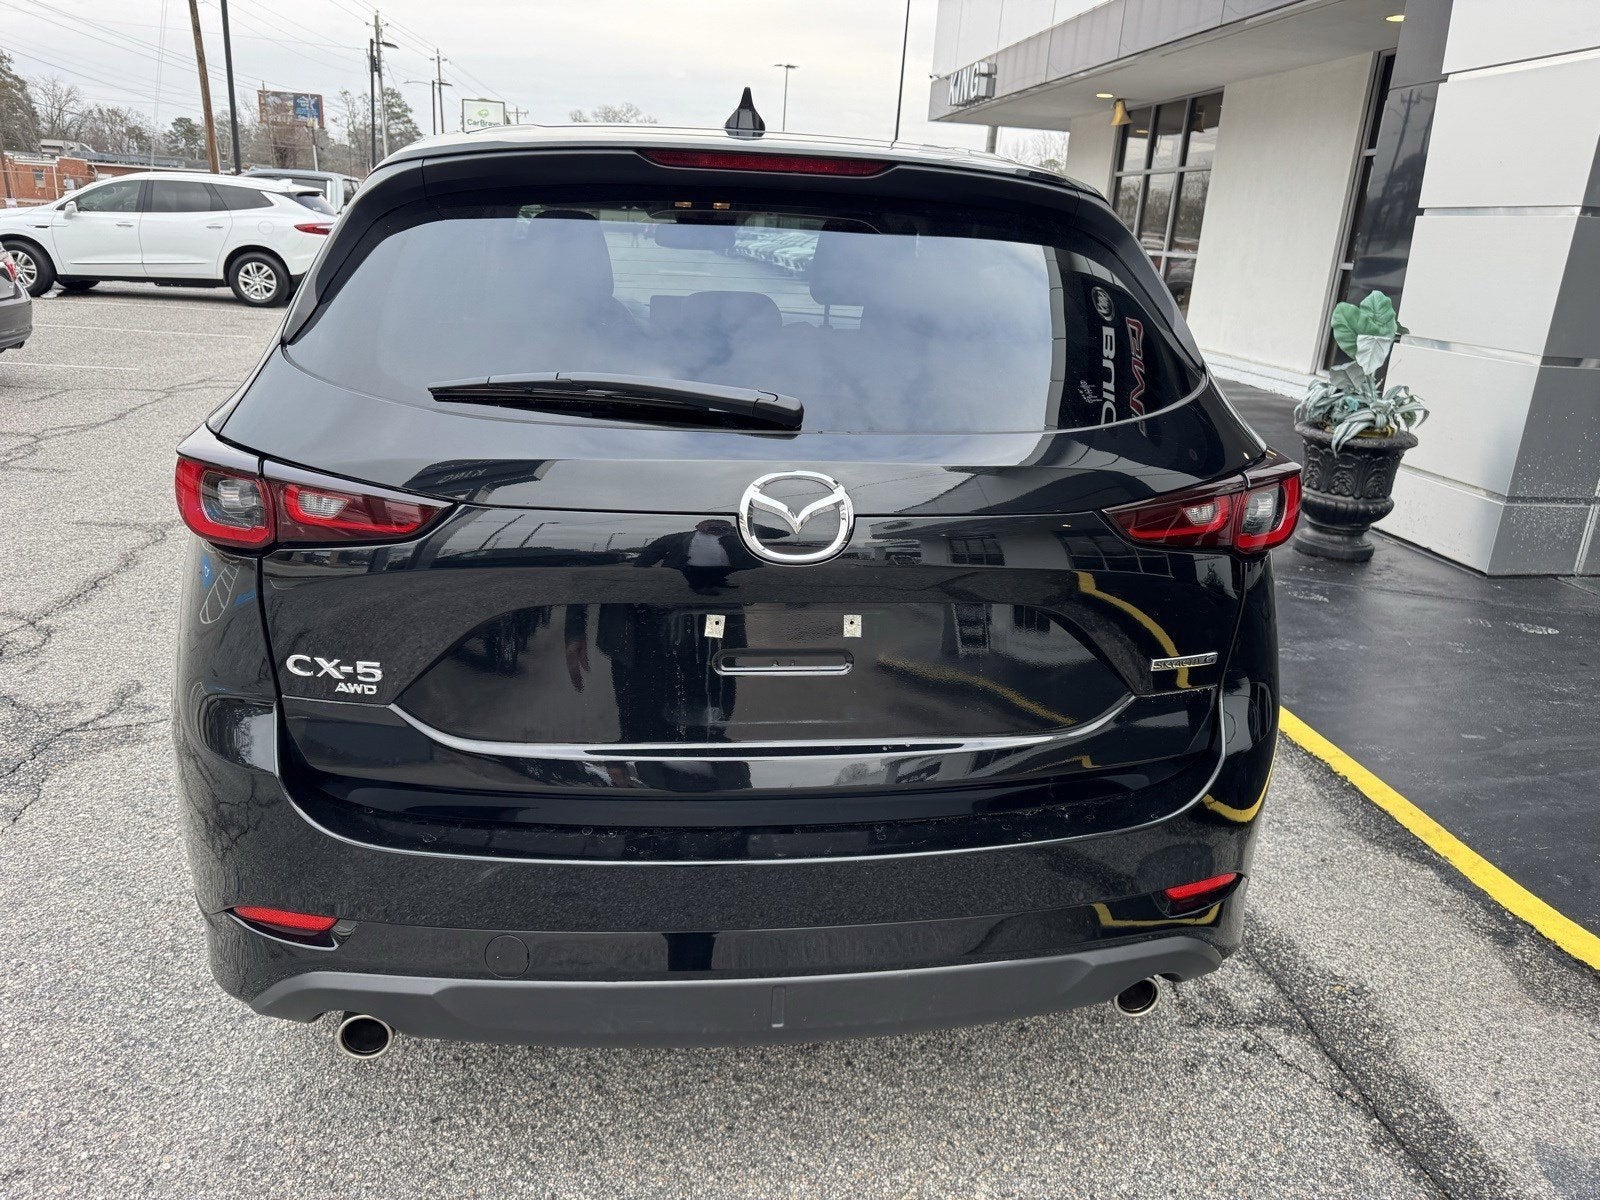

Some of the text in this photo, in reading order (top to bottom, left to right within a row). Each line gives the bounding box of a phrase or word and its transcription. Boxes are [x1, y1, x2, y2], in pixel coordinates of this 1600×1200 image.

[948, 61, 982, 106] KING
[286, 654, 383, 682] CX-5
[335, 682, 377, 695] AWD
